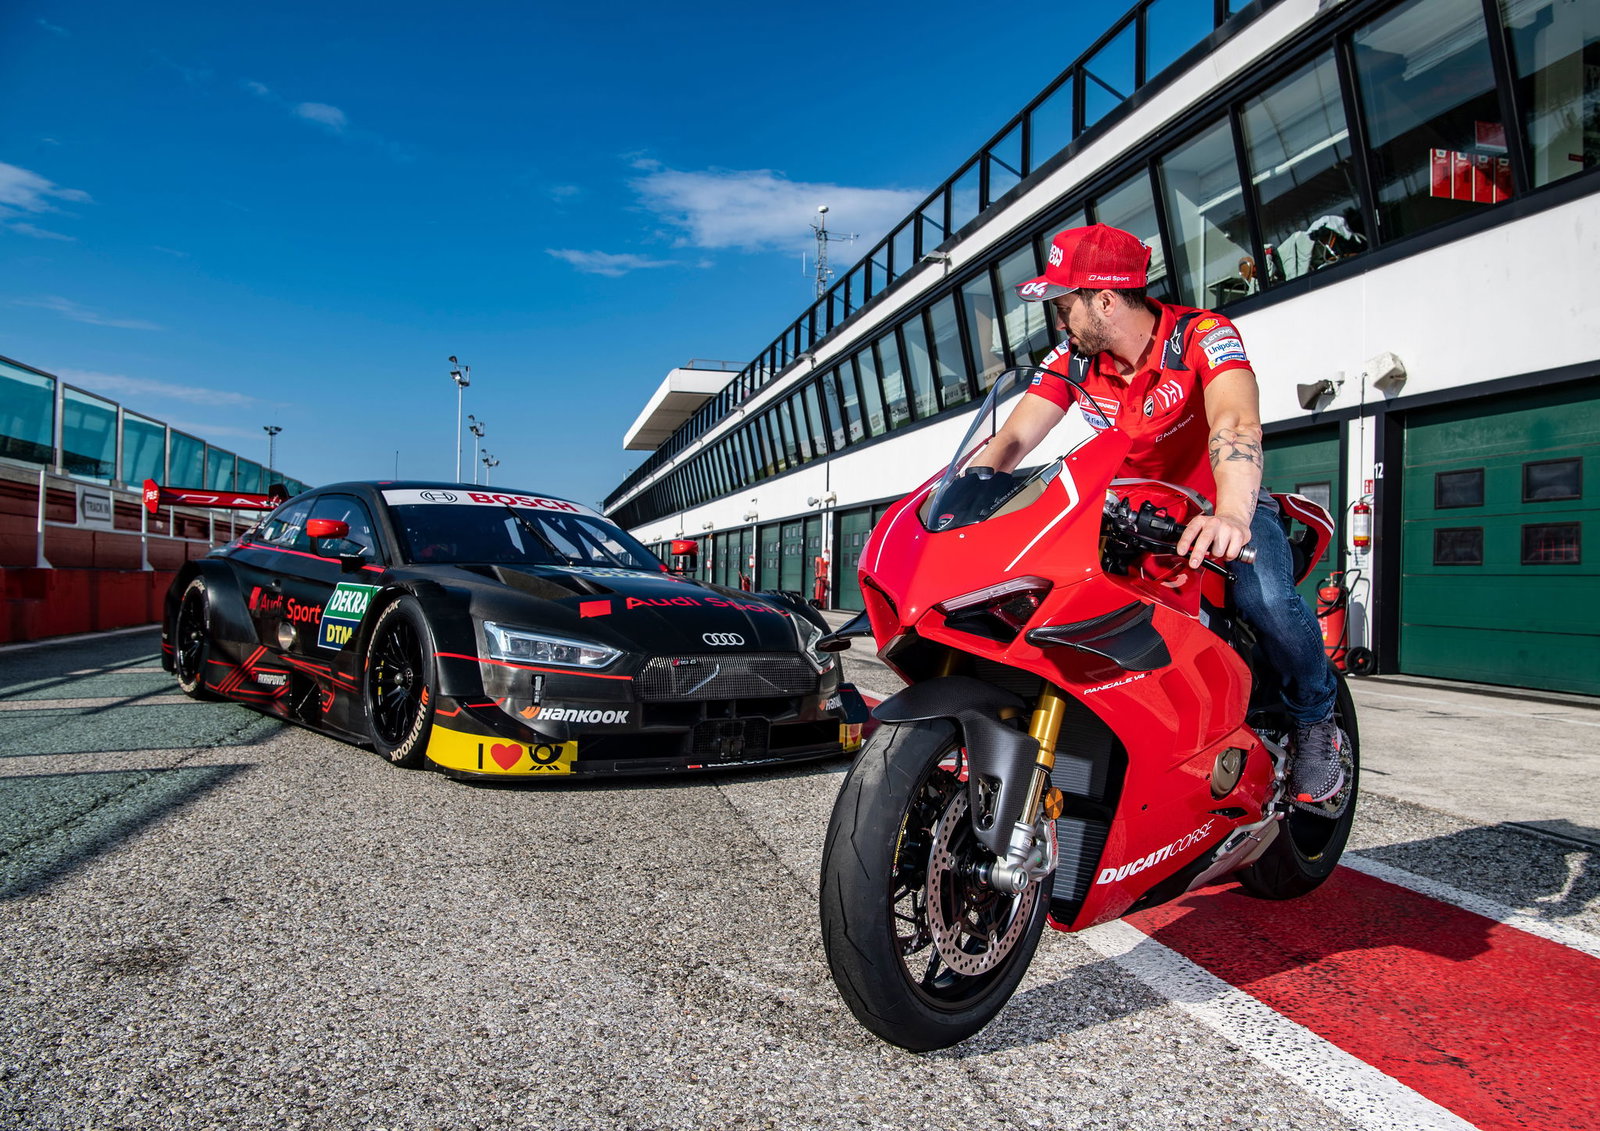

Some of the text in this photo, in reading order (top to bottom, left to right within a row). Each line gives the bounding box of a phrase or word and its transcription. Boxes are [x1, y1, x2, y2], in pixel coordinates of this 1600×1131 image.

[1021, 282, 1048, 297] 04
[1203, 328, 1233, 346] Lenovo
[1163, 413, 1195, 438] Audi Sport
[1374, 462, 1384, 479] 12
[86, 500, 103, 513] TRACK
[467, 492, 580, 513] BOSCH
[260, 593, 322, 625] Audi Sport
[330, 589, 369, 614] DEKRA
[626, 596, 791, 617] Audi Sport
[326, 623, 353, 645] DTM
[1083, 676, 1133, 695] PANIGALE
[478, 743, 484, 770] I
